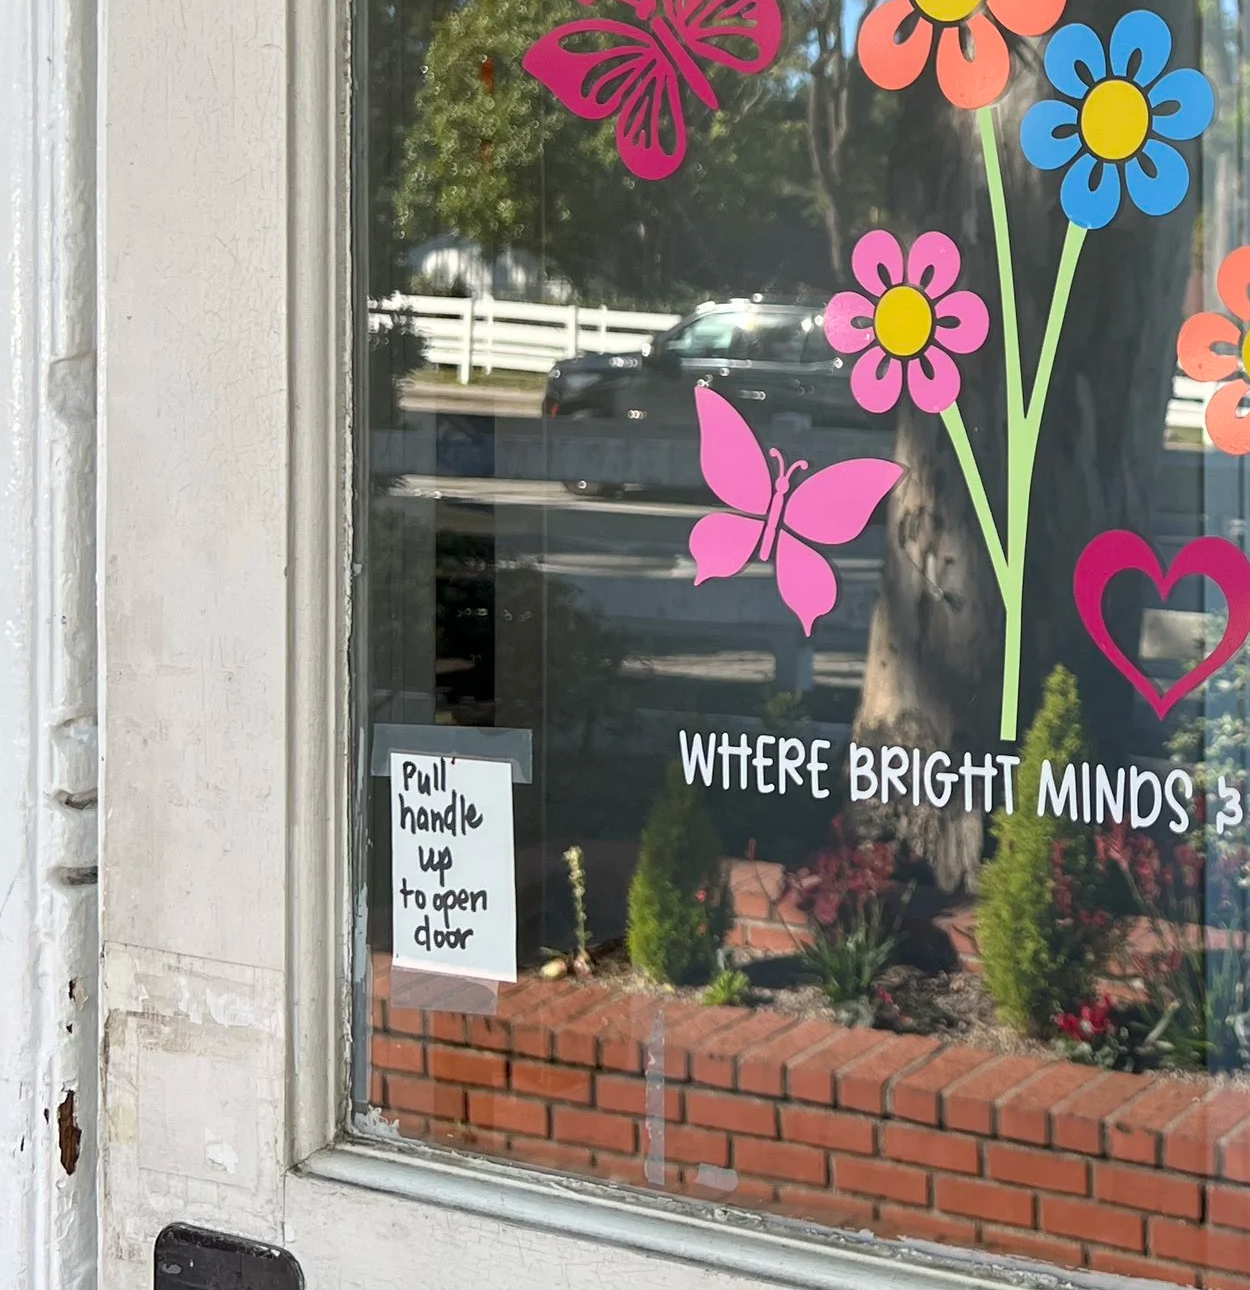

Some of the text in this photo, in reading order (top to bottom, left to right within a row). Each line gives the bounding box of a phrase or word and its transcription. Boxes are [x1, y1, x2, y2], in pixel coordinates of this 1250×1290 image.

[403, 757, 446, 796] Pull
[679, 729, 831, 799] WHERE
[849, 742, 1020, 815] BRIGHT
[1037, 759, 1192, 833] MINDS
[398, 789, 483, 837] handle
[418, 845, 452, 887] up
[400, 878, 488, 929] to open
[414, 914, 474, 952] door
